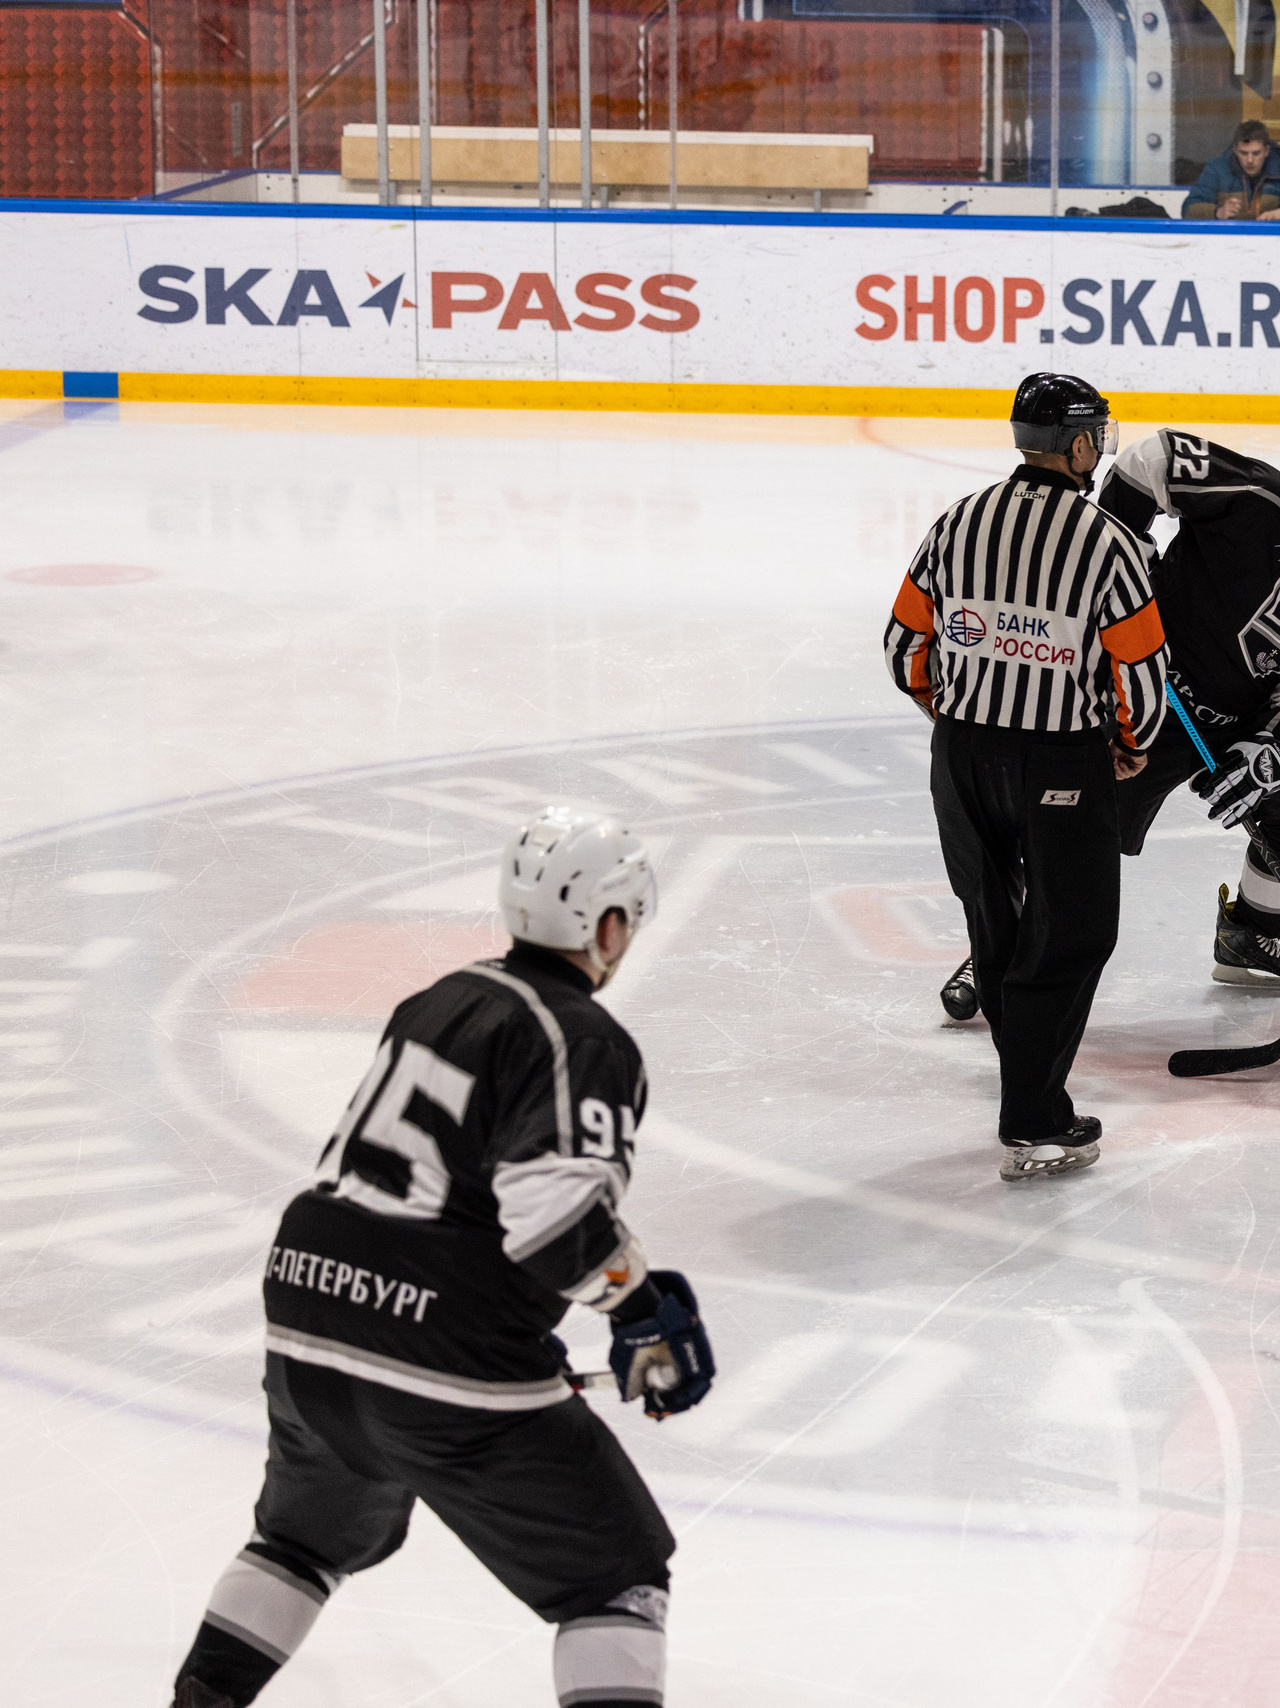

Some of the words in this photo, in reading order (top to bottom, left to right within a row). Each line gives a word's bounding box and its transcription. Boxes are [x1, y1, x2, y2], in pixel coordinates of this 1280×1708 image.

[136, 264, 351, 327] SKA
[430, 271, 701, 332] PASS
[1172, 434, 1209, 480] 22
[1014, 490, 1046, 500] LUTCH
[997, 611, 1051, 639] БАНК
[993, 636, 1076, 666] РОССИЯ
